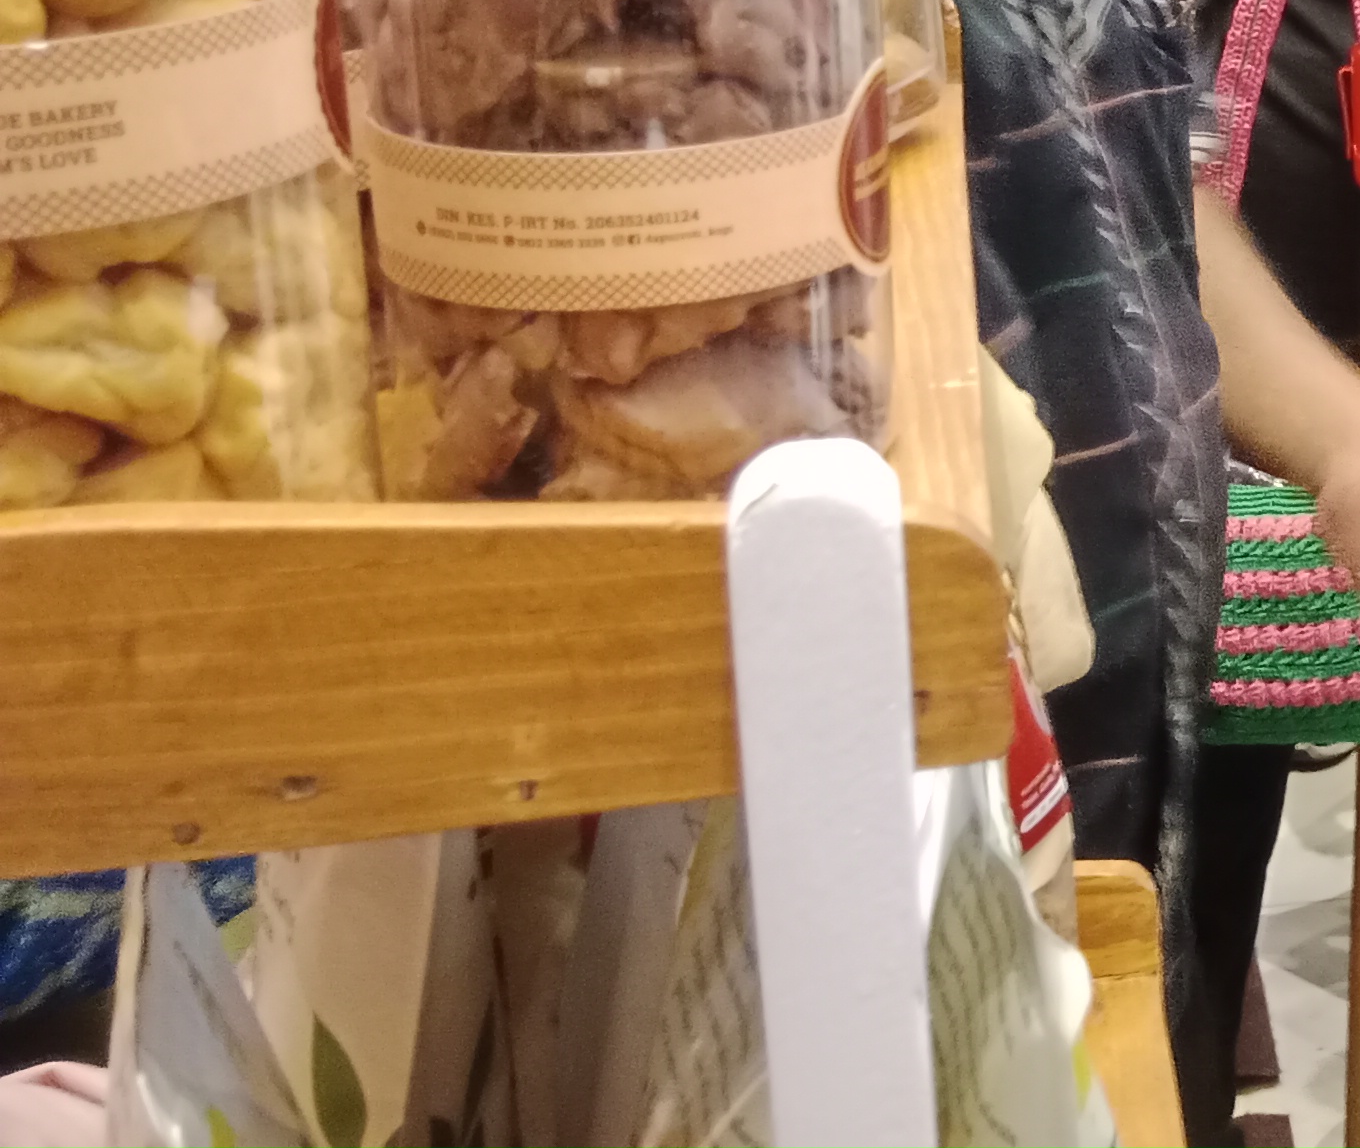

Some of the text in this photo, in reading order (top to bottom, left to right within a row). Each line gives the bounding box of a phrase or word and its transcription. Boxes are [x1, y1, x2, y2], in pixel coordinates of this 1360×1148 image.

[28, 99, 118, 128] BAKERY
[5, 119, 126, 152] GOODNESS
[39, 147, 98, 170] LOVE
